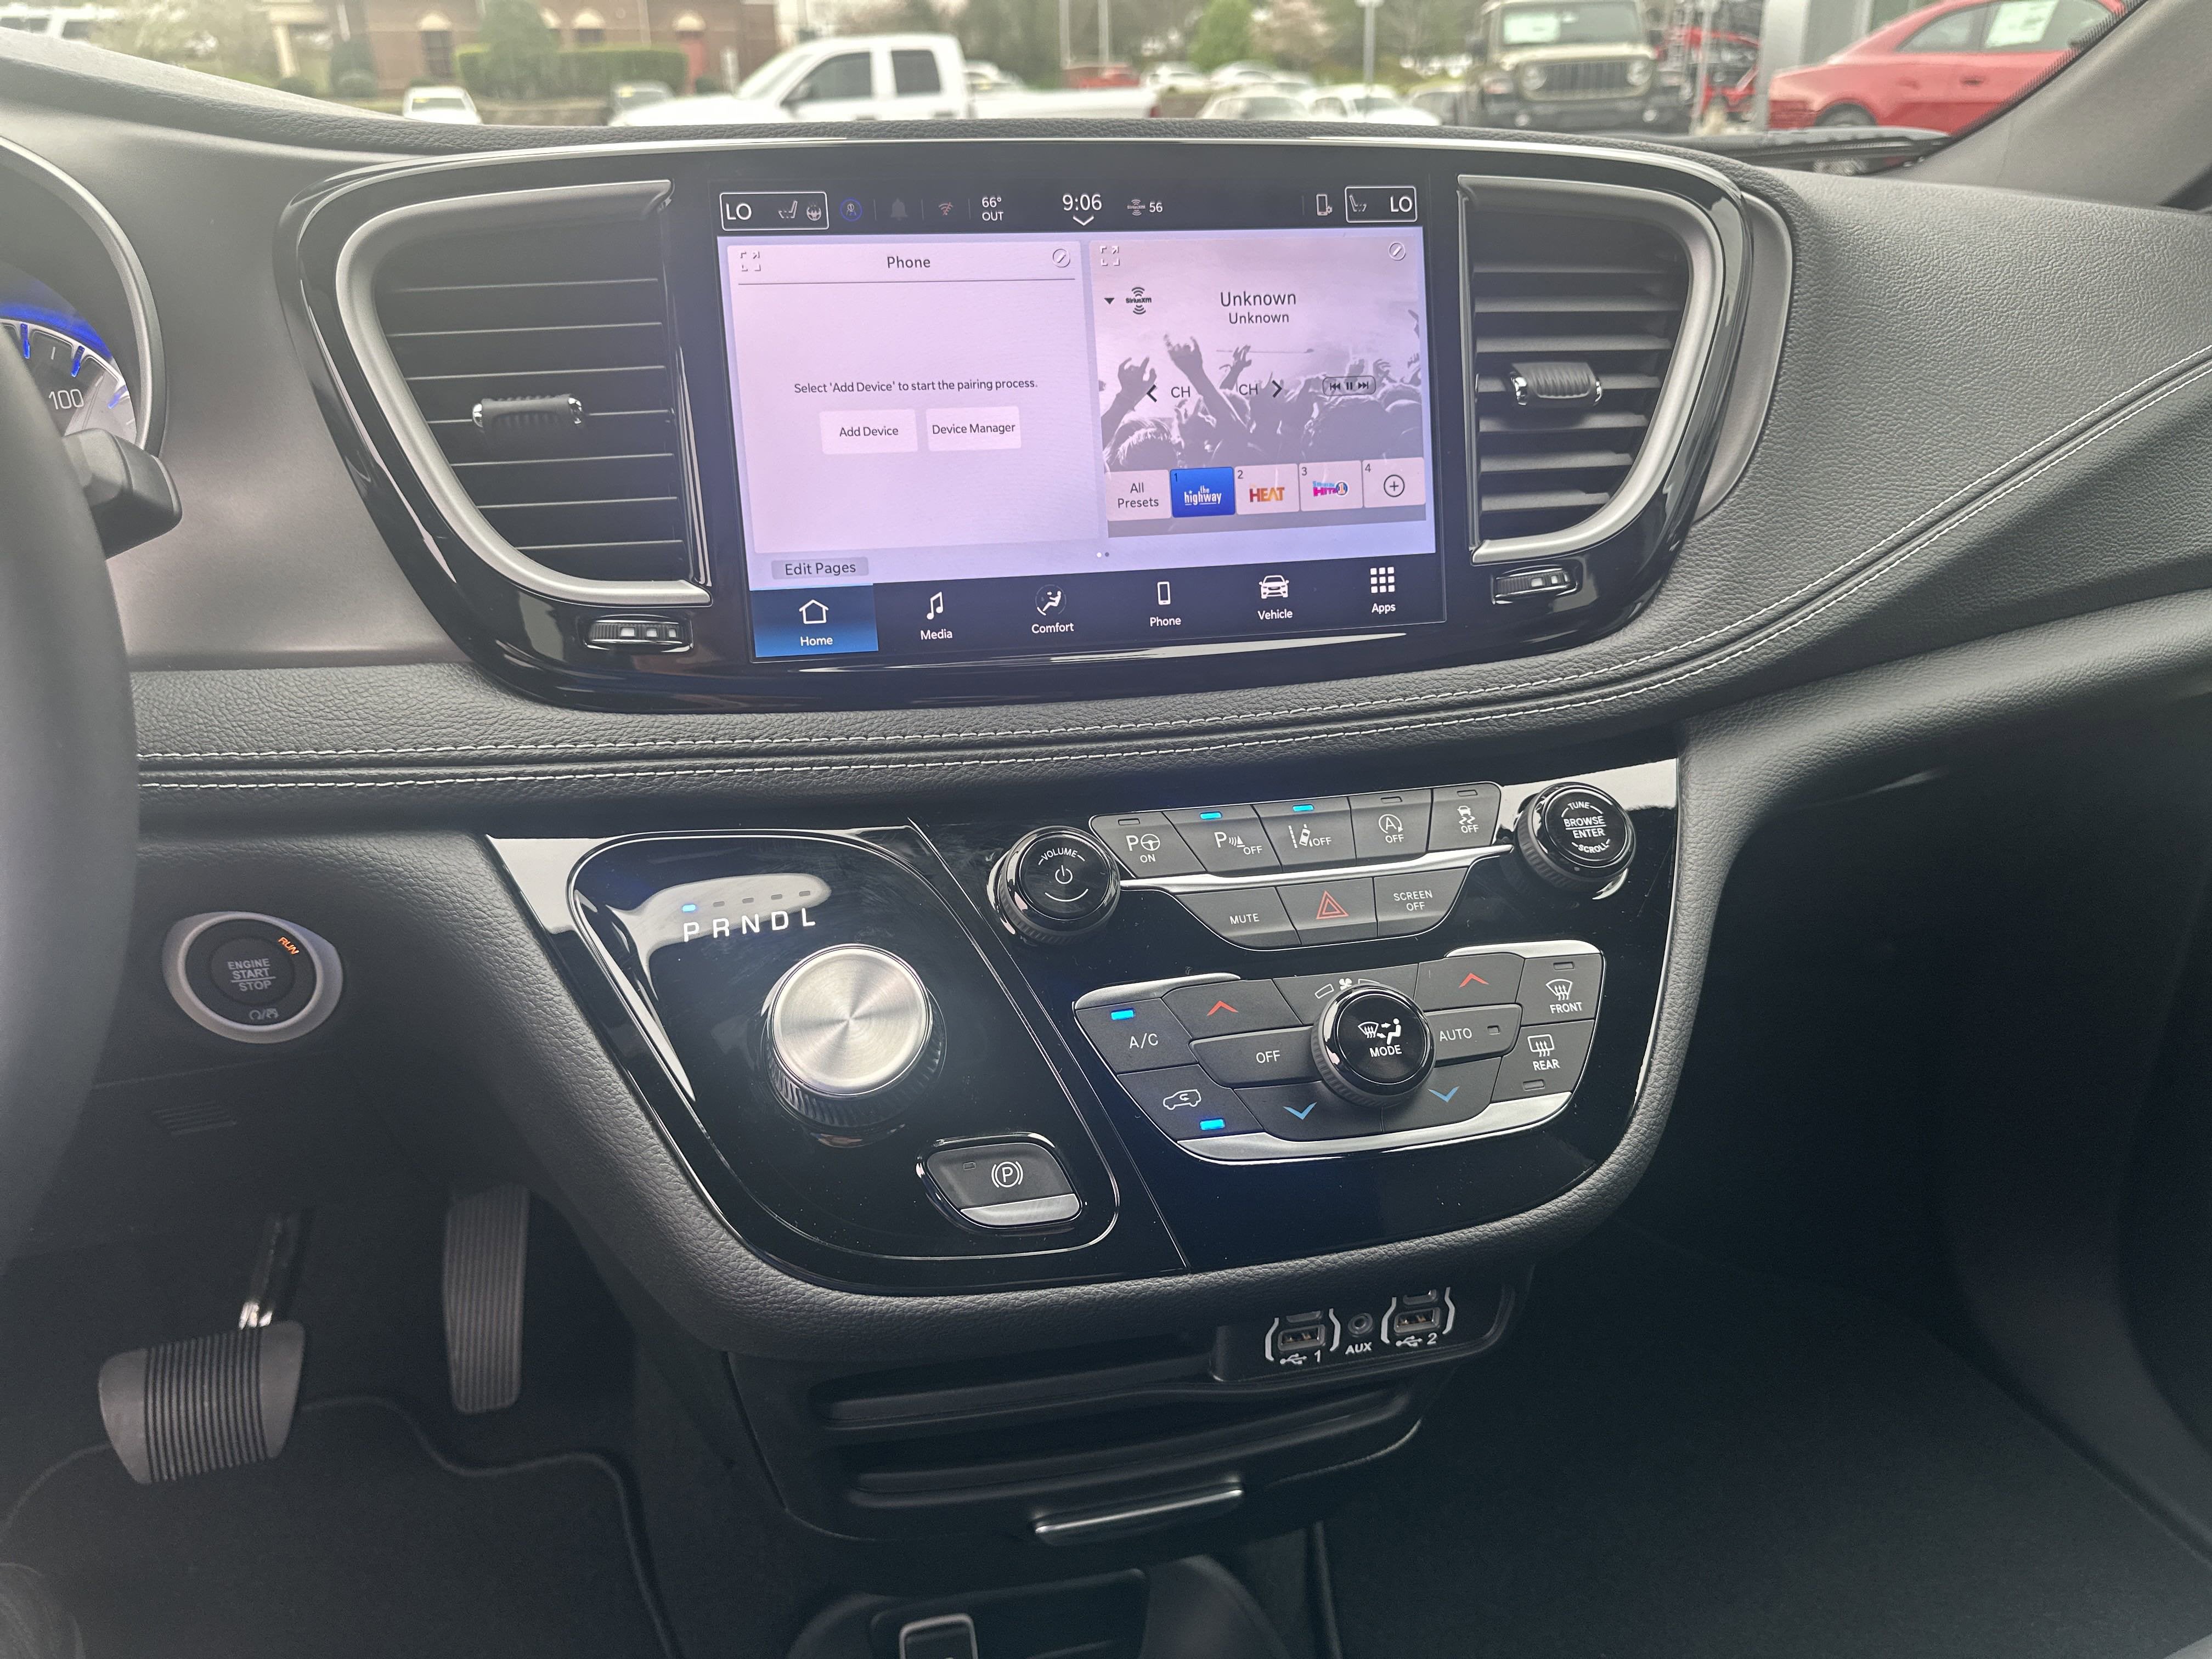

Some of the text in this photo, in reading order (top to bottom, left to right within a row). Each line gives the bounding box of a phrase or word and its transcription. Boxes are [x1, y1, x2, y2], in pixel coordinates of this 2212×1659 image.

[981, 197, 1001, 208] 66°
[1062, 194, 1102, 211] 9:06
[1149, 202, 1163, 213] 56
[1390, 196, 1412, 212] LO
[726, 203, 752, 219] LO
[982, 212, 1003, 221] OUT
[887, 256, 930, 268] Phone
[1220, 291, 1296, 307] Unknown
[1228, 312, 1289, 324] Unknown
[794, 383, 827, 393] Select
[898, 382, 909, 391] to
[911, 381, 935, 391] start
[938, 380, 955, 390] the
[957, 379, 992, 392] pairing
[995, 379, 1038, 390] process.
[1238, 384, 1258, 396] CH
[1171, 387, 1190, 398] CH
[49, 388, 84, 410] 100
[839, 426, 899, 437] Add Device
[933, 424, 1015, 435] Device Manager
[1301, 467, 1307, 476] 3
[1365, 464, 1371, 472] 4
[1174, 473, 1178, 482] 1
[1237, 470, 1243, 479] 2
[1130, 483, 1144, 493] All
[1184, 491, 1222, 505] highway
[1249, 487, 1285, 503] HEAT
[1118, 496, 1159, 509] Presets
[785, 562, 856, 575] Edit Pages
[1257, 608, 1293, 620] Vehicle
[1372, 602, 1396, 614] Apps
[1150, 616, 1181, 627] Phone
[1031, 622, 1074, 634] Comfort
[920, 629, 953, 640] Media
[800, 635, 833, 647] Home
[1567, 801, 1590, 810] TUNE
[1564, 816, 1605, 827] BROWSE
[1461, 824, 1479, 834] OFF
[1573, 828, 1605, 838] ENTER
[1312, 836, 1331, 847] OFF
[1385, 833, 1404, 843] OFF
[1243, 845, 1262, 856] OFF
[1578, 842, 1609, 853] SCROLL
[1041, 848, 1078, 861] VOLUME
[1139, 854, 1156, 863] ON
[1393, 890, 1433, 901] SCREEN
[1406, 902, 1425, 911] OFF
[1229, 913, 1260, 924] MUTE
[684, 908, 816, 942] P R N D L
[278, 936, 300, 955] RUN
[228, 958, 270, 970] ENGINE
[232, 968, 269, 980] START
[239, 980, 272, 991] STOP
[1549, 1002, 1583, 1014] FRONT
[1128, 1033, 1159, 1049] A/C
[1439, 1029, 1472, 1041] AUTO
[1256, 1051, 1280, 1063] OFF
[1370, 1045, 1402, 1057] MODE
[1532, 1059, 1560, 1070] REAR
[1427, 1333, 1437, 1345] 2
[1345, 1342, 1372, 1355] AUX
[1314, 1350, 1321, 1363] 1
